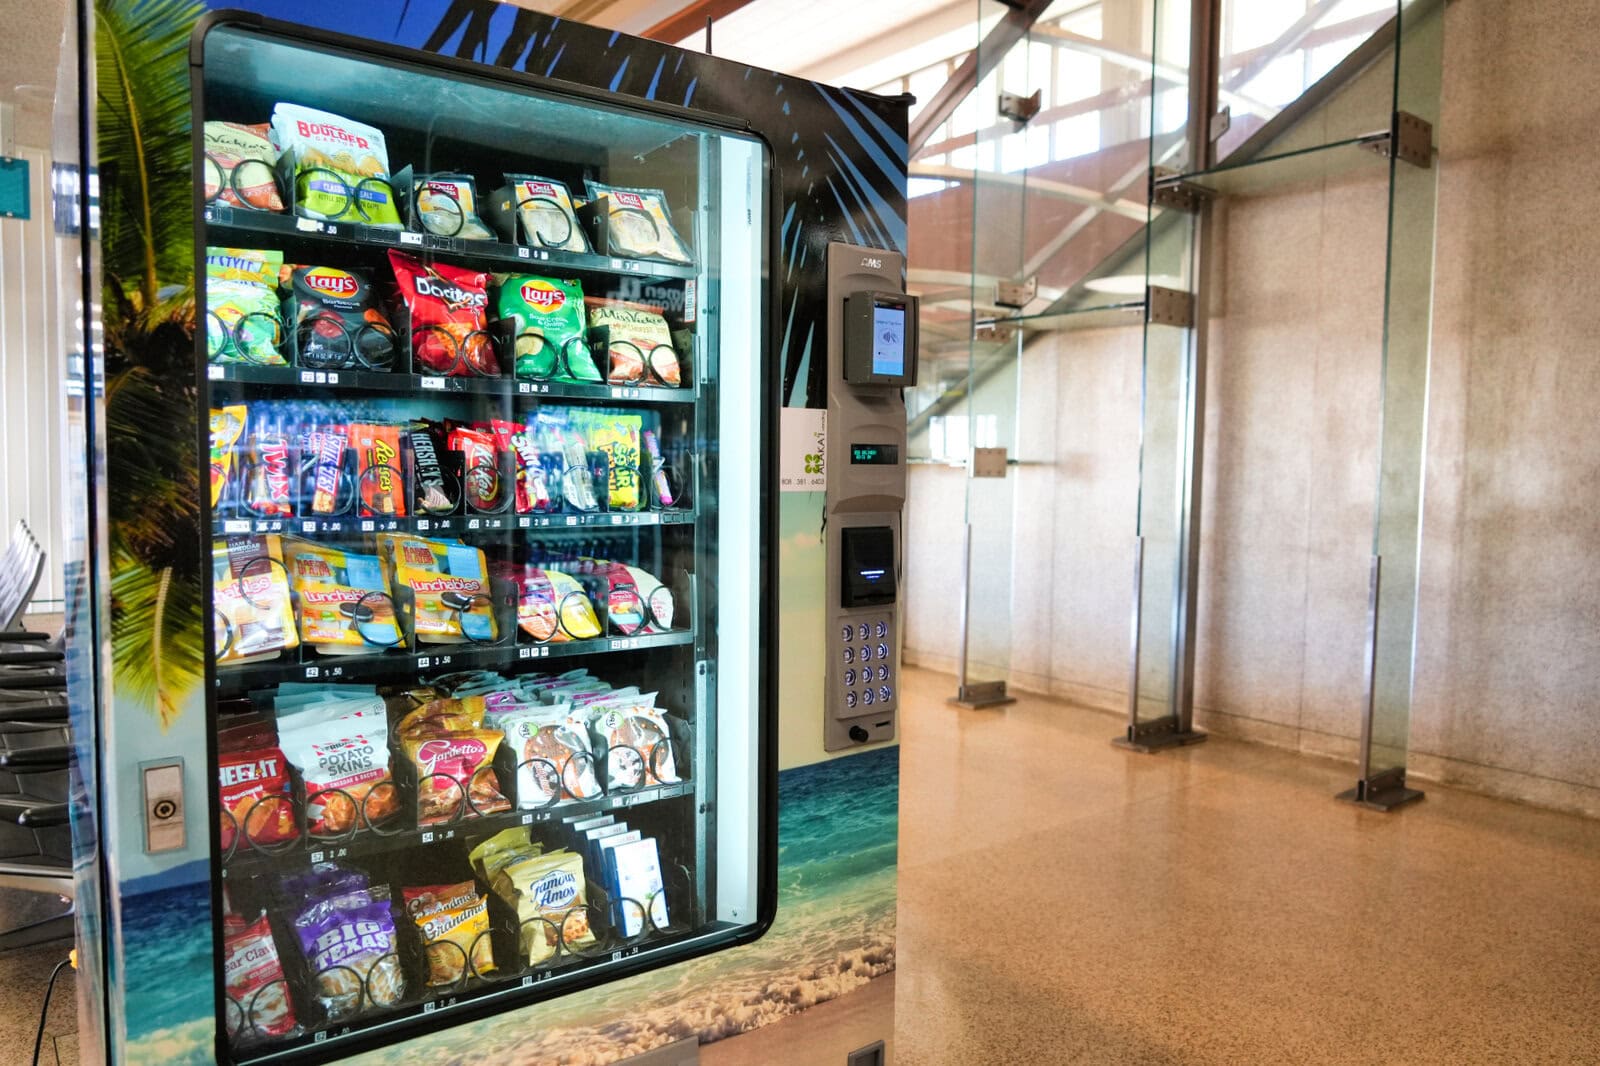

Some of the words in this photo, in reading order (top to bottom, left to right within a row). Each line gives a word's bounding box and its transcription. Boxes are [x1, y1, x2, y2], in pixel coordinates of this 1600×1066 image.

[296, 120, 369, 150] BOULDER
[310, 275, 354, 293] Lay's
[415, 276, 485, 307] Doritos
[524, 286, 563, 305] Lay's
[260, 438, 290, 501] TWIX
[374, 439, 395, 492] Reese's
[318, 745, 374, 769] POTATO
[327, 756, 373, 777] SKINS
[415, 739, 485, 777] Gardetto's
[530, 872, 578, 904] Famous
[539, 887, 578, 908] Amos
[314, 931, 390, 970] TEXAS
[316, 920, 382, 951] BIG
